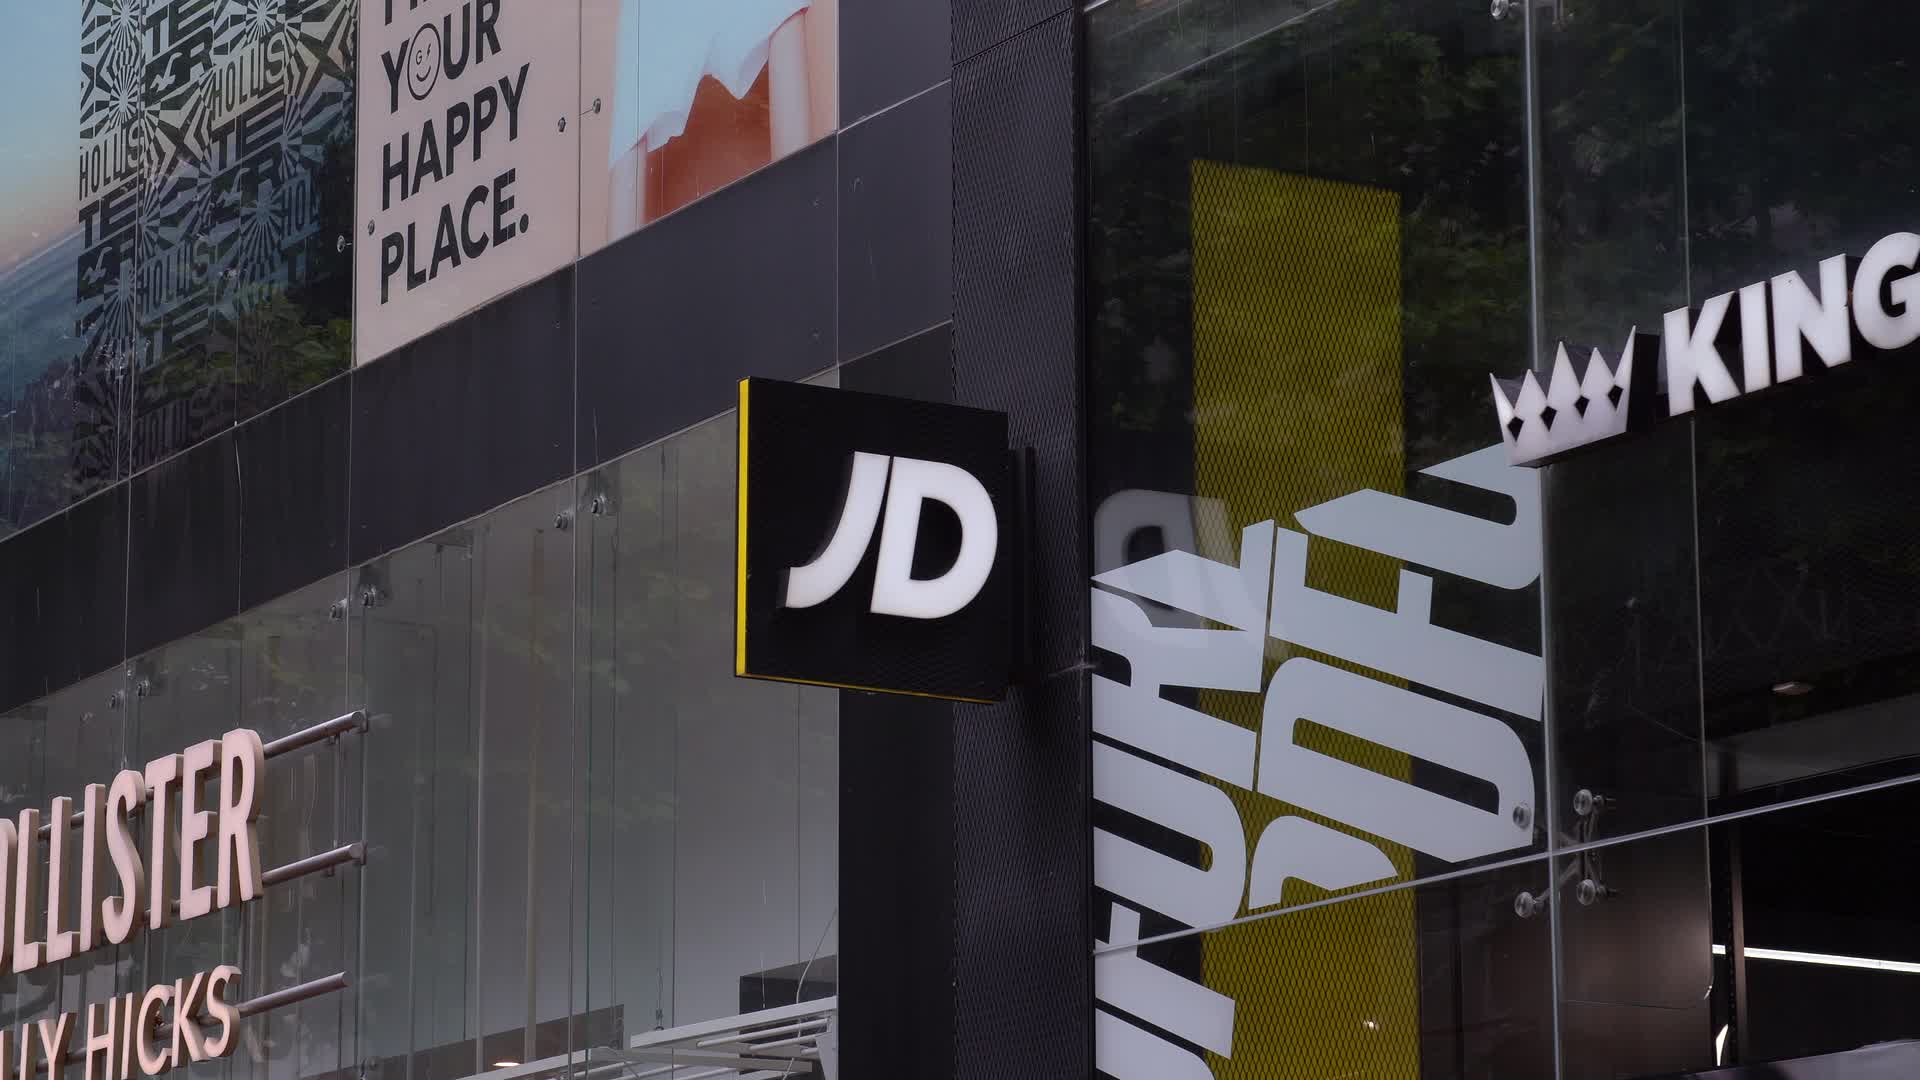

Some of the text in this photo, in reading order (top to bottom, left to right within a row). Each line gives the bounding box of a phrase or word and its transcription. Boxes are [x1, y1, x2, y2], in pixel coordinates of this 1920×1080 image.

[211, 31, 286, 120] HOLLIS
[380, 0, 502, 114] YOUR
[381, 63, 530, 211] HAPPY
[380, 168, 530, 305] PLACE.
[1663, 231, 1920, 417] KING
[784, 450, 999, 619] JD
[85, 964, 242, 1080] HICKS
